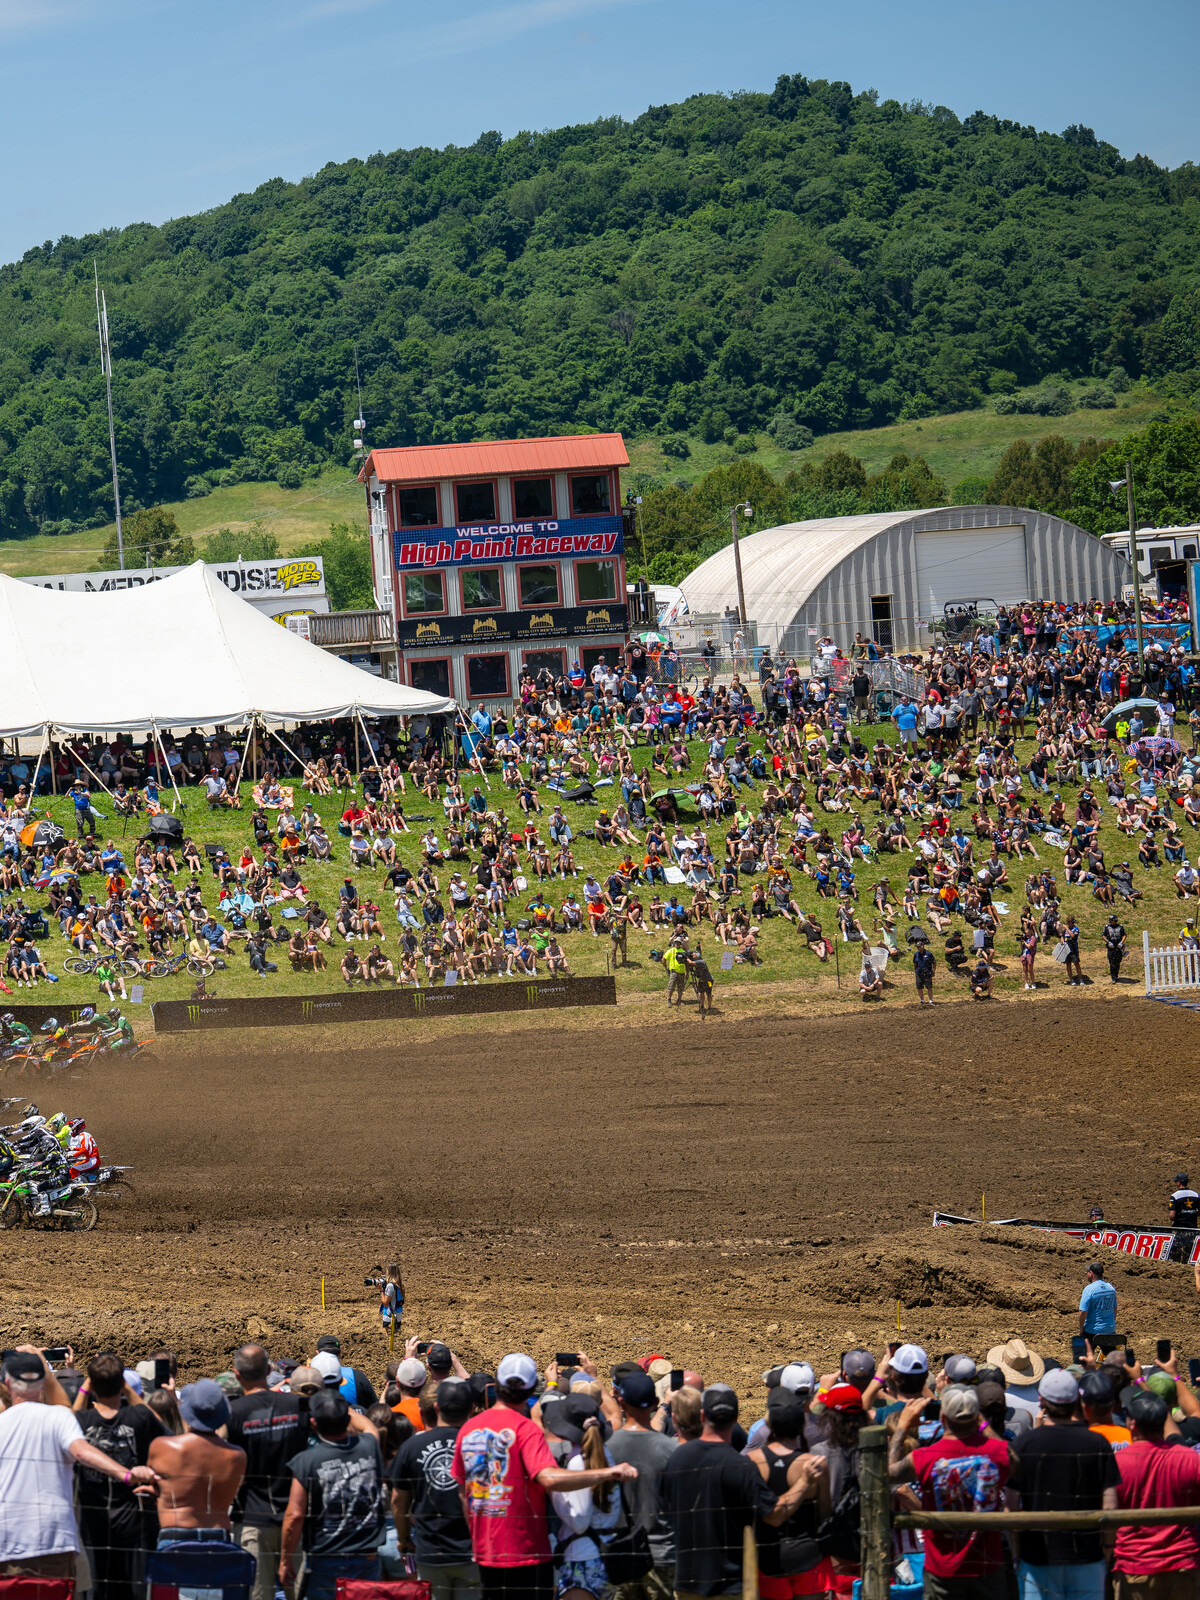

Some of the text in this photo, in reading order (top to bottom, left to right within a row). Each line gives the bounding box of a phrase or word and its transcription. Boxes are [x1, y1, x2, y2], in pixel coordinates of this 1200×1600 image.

[456, 521, 559, 537] WELCOME TO
[399, 532, 618, 566] High Point Raceway
[276, 561, 317, 583] MOTO
[283, 570, 322, 590] TEES
[416, 1440, 443, 1464] LAKE
